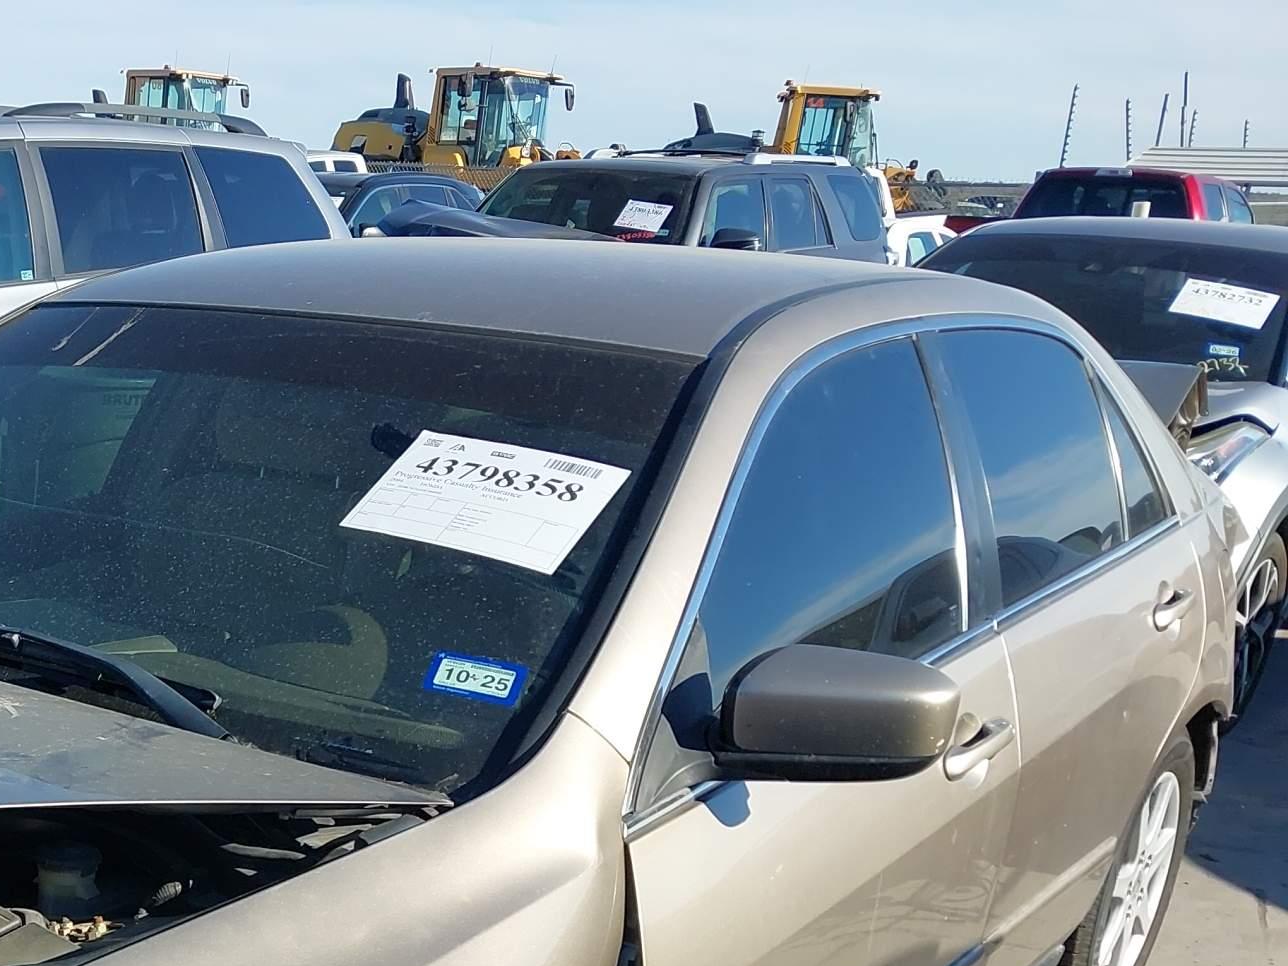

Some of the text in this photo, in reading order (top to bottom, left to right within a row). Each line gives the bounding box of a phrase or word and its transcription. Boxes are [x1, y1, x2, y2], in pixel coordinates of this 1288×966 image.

[1192, 288, 1263, 305] 43782732
[415, 456, 584, 503] 43798358
[444, 478, 480, 491] Casualty
[481, 484, 523, 500] Insurance
[445, 667, 470, 683] 10
[480, 675, 510, 691] 25
